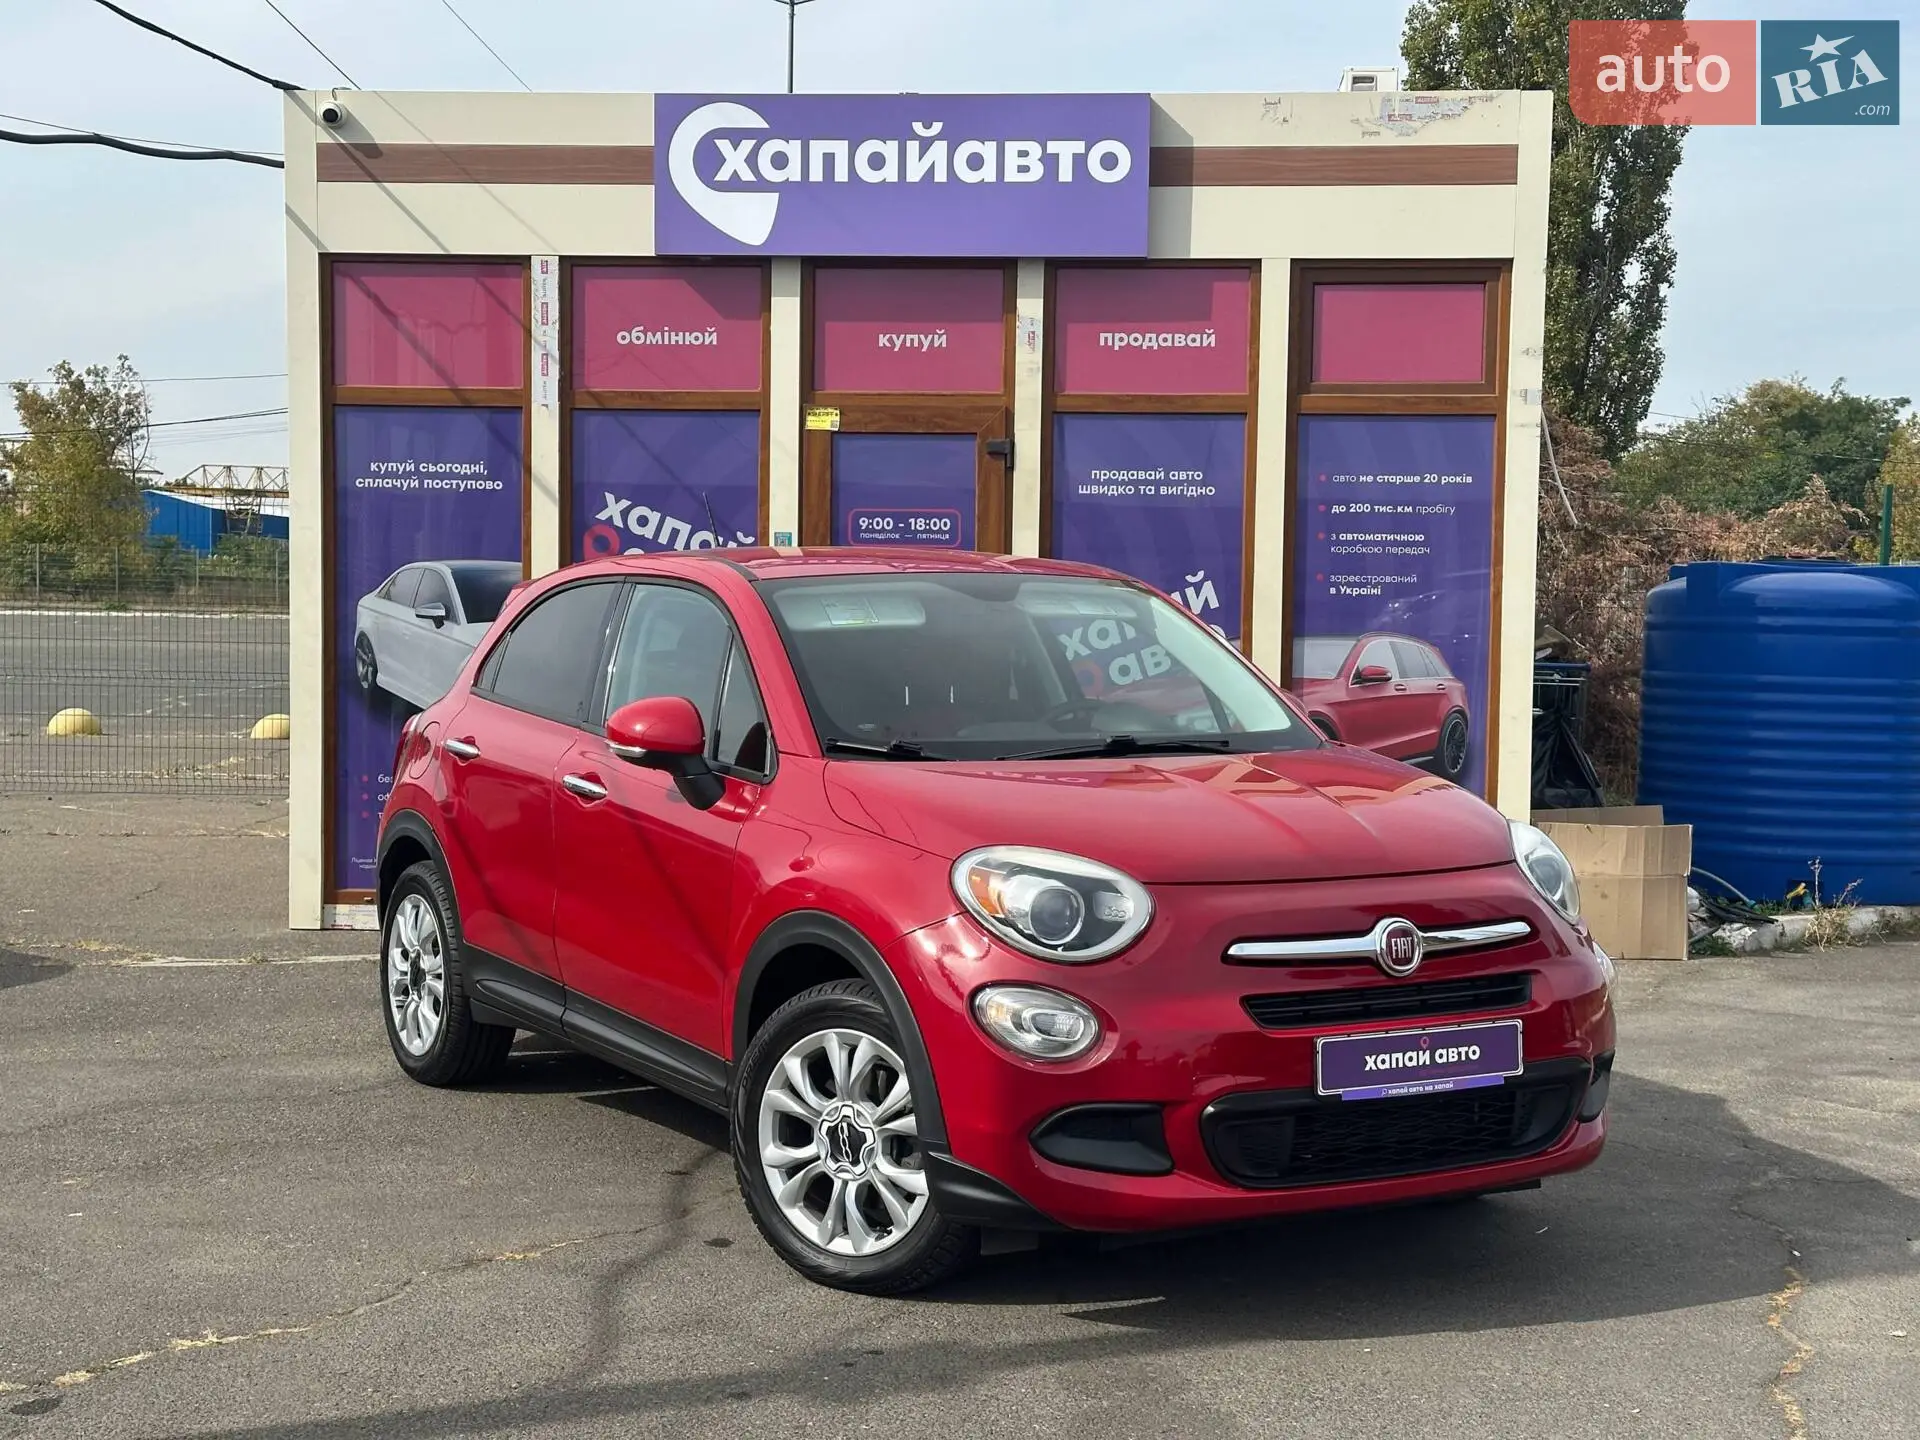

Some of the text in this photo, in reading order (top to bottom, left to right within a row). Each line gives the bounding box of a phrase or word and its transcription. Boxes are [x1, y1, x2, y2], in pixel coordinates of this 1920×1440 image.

[713, 121, 1132, 184] хапайавто
[616, 326, 718, 347] обмінюй
[878, 330, 947, 352] купуй
[1099, 329, 1216, 351] продавай
[370, 459, 488, 476] купуй сьогодні,
[1091, 467, 1204, 482] продавай авто
[355, 476, 503, 492] сплачуй поступово
[1332, 473, 1473, 485] авто не старше 20 років
[1078, 483, 1216, 498] швидко та вигідно
[1331, 504, 1347, 514] до
[1349, 503, 1371, 513] 200
[595, 491, 755, 552] хапа
[858, 517, 894, 531] 9:00
[908, 517, 951, 531] 18:00
[1339, 532, 1425, 542] автоматичною
[1330, 544, 1430, 555] коробкою передач
[1329, 573, 1417, 584] зареєстрований
[1339, 585, 1382, 597] Україні
[1391, 936, 1415, 960] FIAT
[1434, 1045, 1481, 1064] авто
